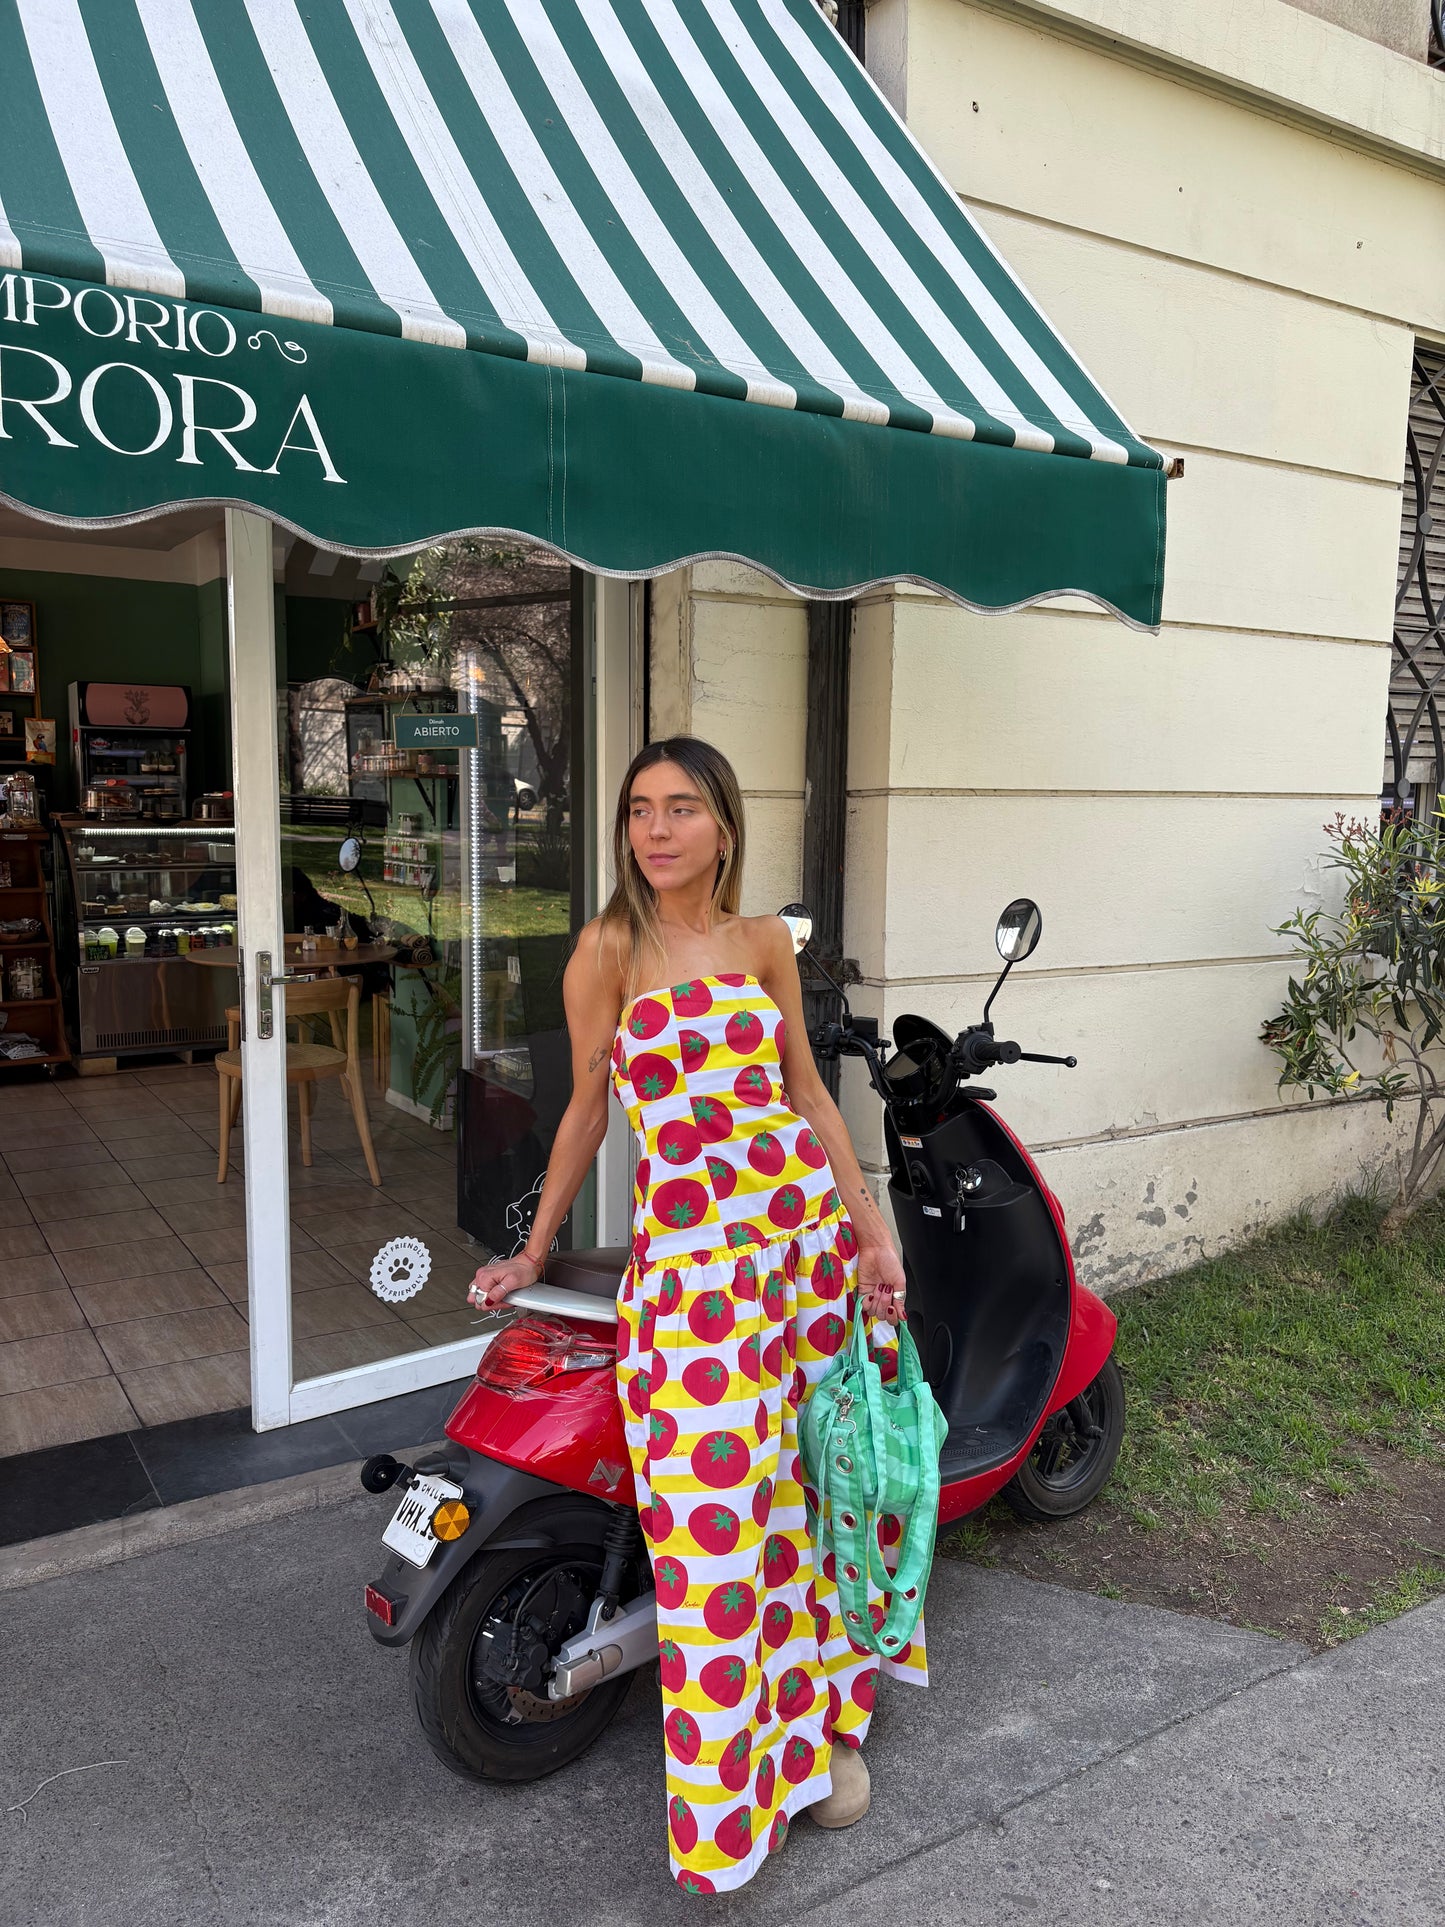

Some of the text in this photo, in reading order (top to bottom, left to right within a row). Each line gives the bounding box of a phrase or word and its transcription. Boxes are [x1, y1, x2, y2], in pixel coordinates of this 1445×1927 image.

[0, 344, 348, 483] RORA
[413, 726, 460, 737] ABIERTO
[377, 1242, 425, 1265] PET FRIENDLY
[377, 1274, 424, 1297] PET FRIENDLY
[421, 1484, 446, 1501] CHILE
